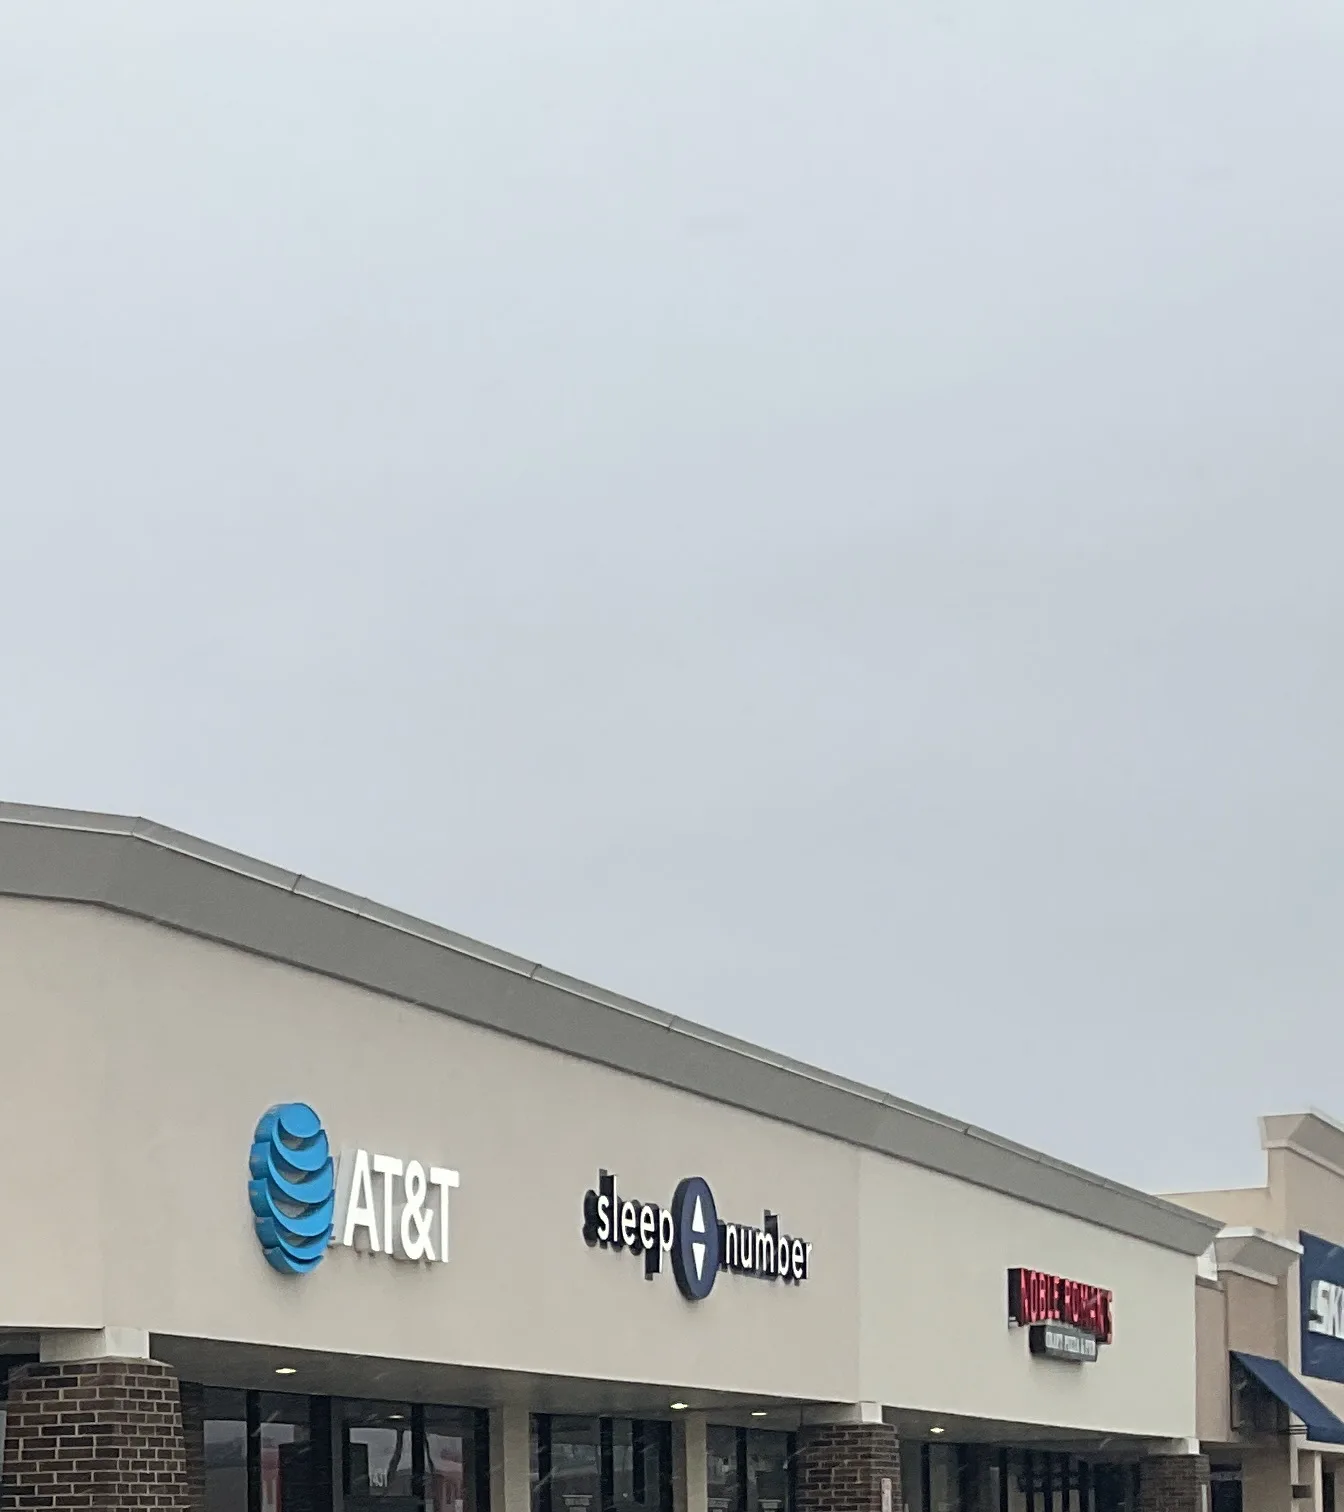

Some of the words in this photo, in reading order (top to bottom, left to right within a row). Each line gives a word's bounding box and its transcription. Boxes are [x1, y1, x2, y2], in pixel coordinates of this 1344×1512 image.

[339, 1148, 460, 1263] AT&T
[594, 1173, 675, 1274] sleep
[724, 1212, 812, 1281] number
[1016, 1267, 1060, 1324] NOBLE
